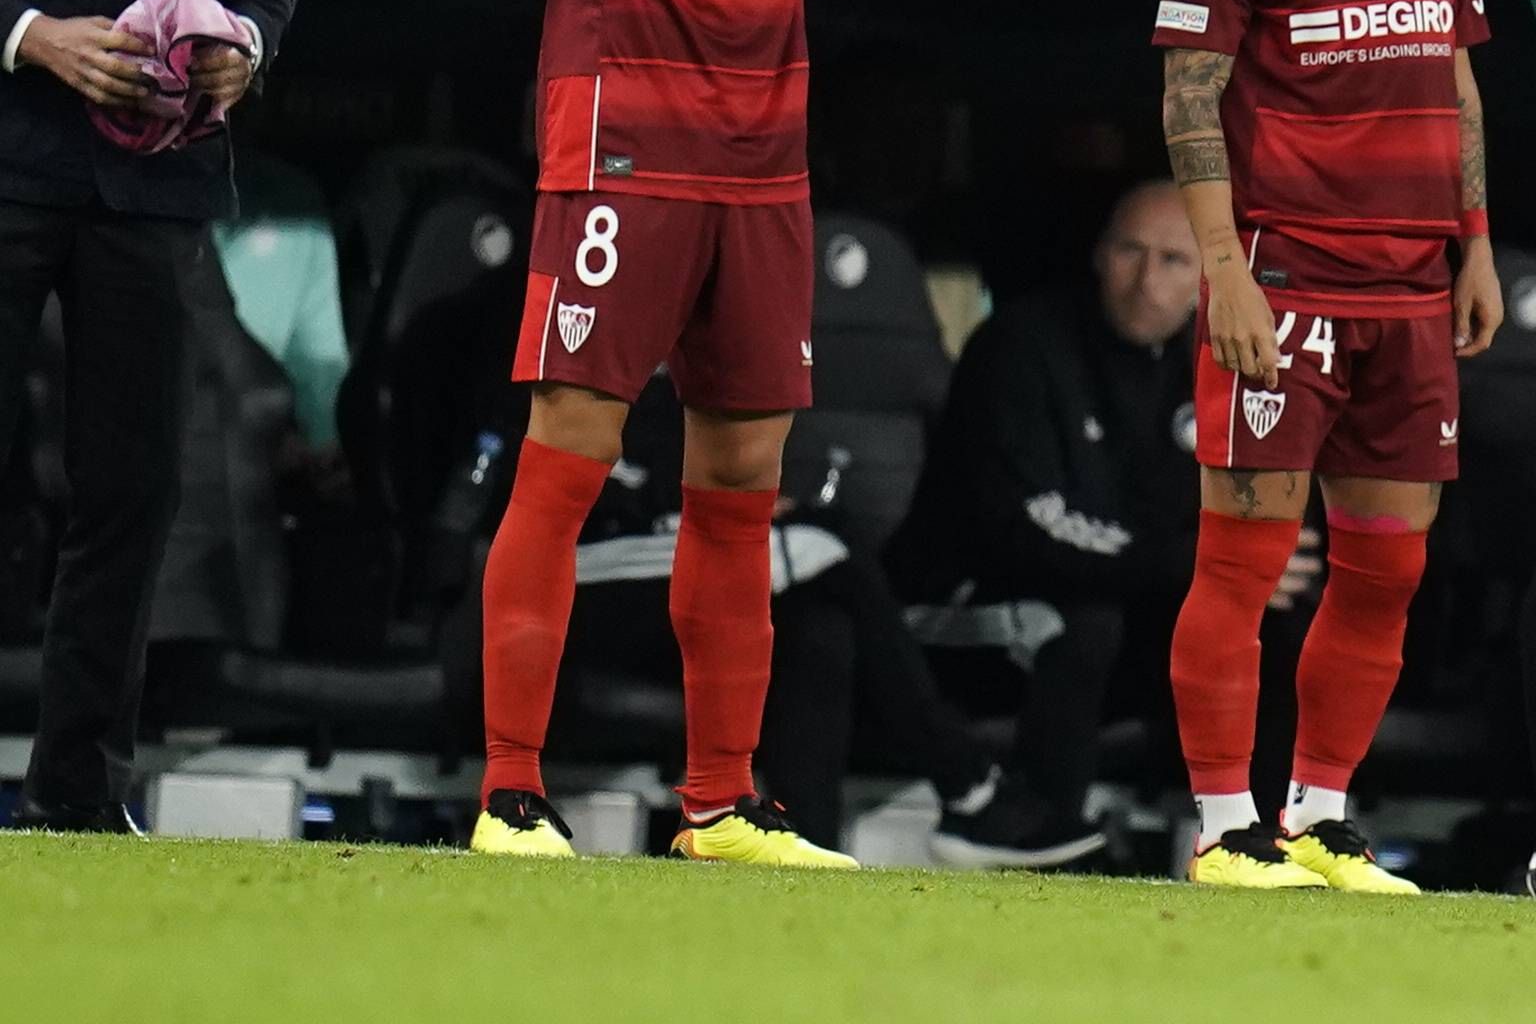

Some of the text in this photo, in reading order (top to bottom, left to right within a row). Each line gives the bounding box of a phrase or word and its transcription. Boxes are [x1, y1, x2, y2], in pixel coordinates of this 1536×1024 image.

[1342, 0, 1455, 41] DEGIRO
[1300, 48, 1368, 66] EUROPE'S
[1369, 43, 1421, 61] LEADING
[575, 204, 620, 288] 8
